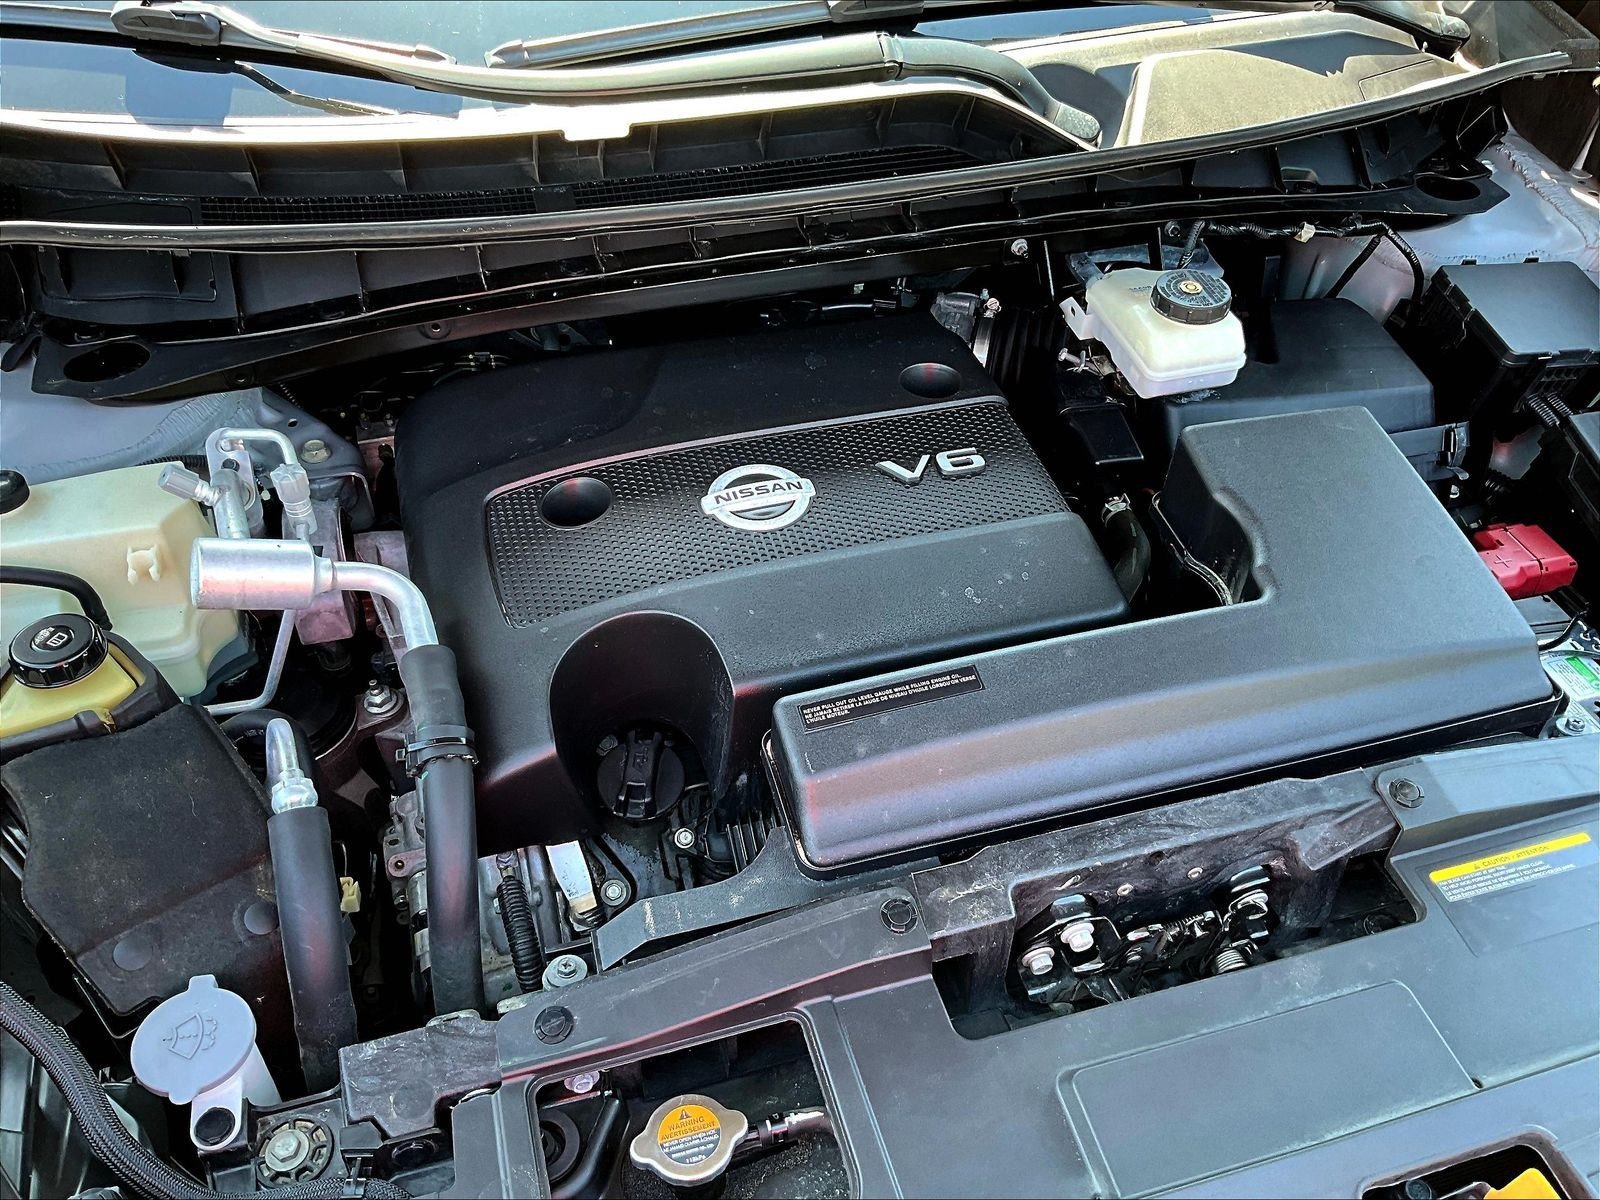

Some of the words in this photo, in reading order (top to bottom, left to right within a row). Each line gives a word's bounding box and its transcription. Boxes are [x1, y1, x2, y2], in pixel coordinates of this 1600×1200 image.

[875, 447, 986, 487] V6
[714, 480, 804, 504] NISSAN
[803, 706, 820, 714] NEVER
[857, 693, 874, 701] LEVEL
[874, 688, 893, 697] GAUGE
[893, 684, 910, 692] WHILE
[910, 680, 930, 688] FILLING
[930, 675, 950, 684] ENGINE
[813, 708, 832, 717] JAMAIS
[832, 703, 854, 712] RETIRER
[862, 697, 880, 705] JAUGE
[888, 690, 907, 699] NIVEAU
[908, 685, 928, 694] D'HUILE
[959, 674, 975, 682] VERSE
[806, 715, 826, 723] L'HUILE
[826, 709, 849, 718] MOTEUR.
[1482, 856, 1511, 867] CAUTION
[1516, 846, 1550, 858] ATTENTION
[661, 1121, 715, 1141] AVERTISSEMENT
[668, 1116, 705, 1131] WARNING
